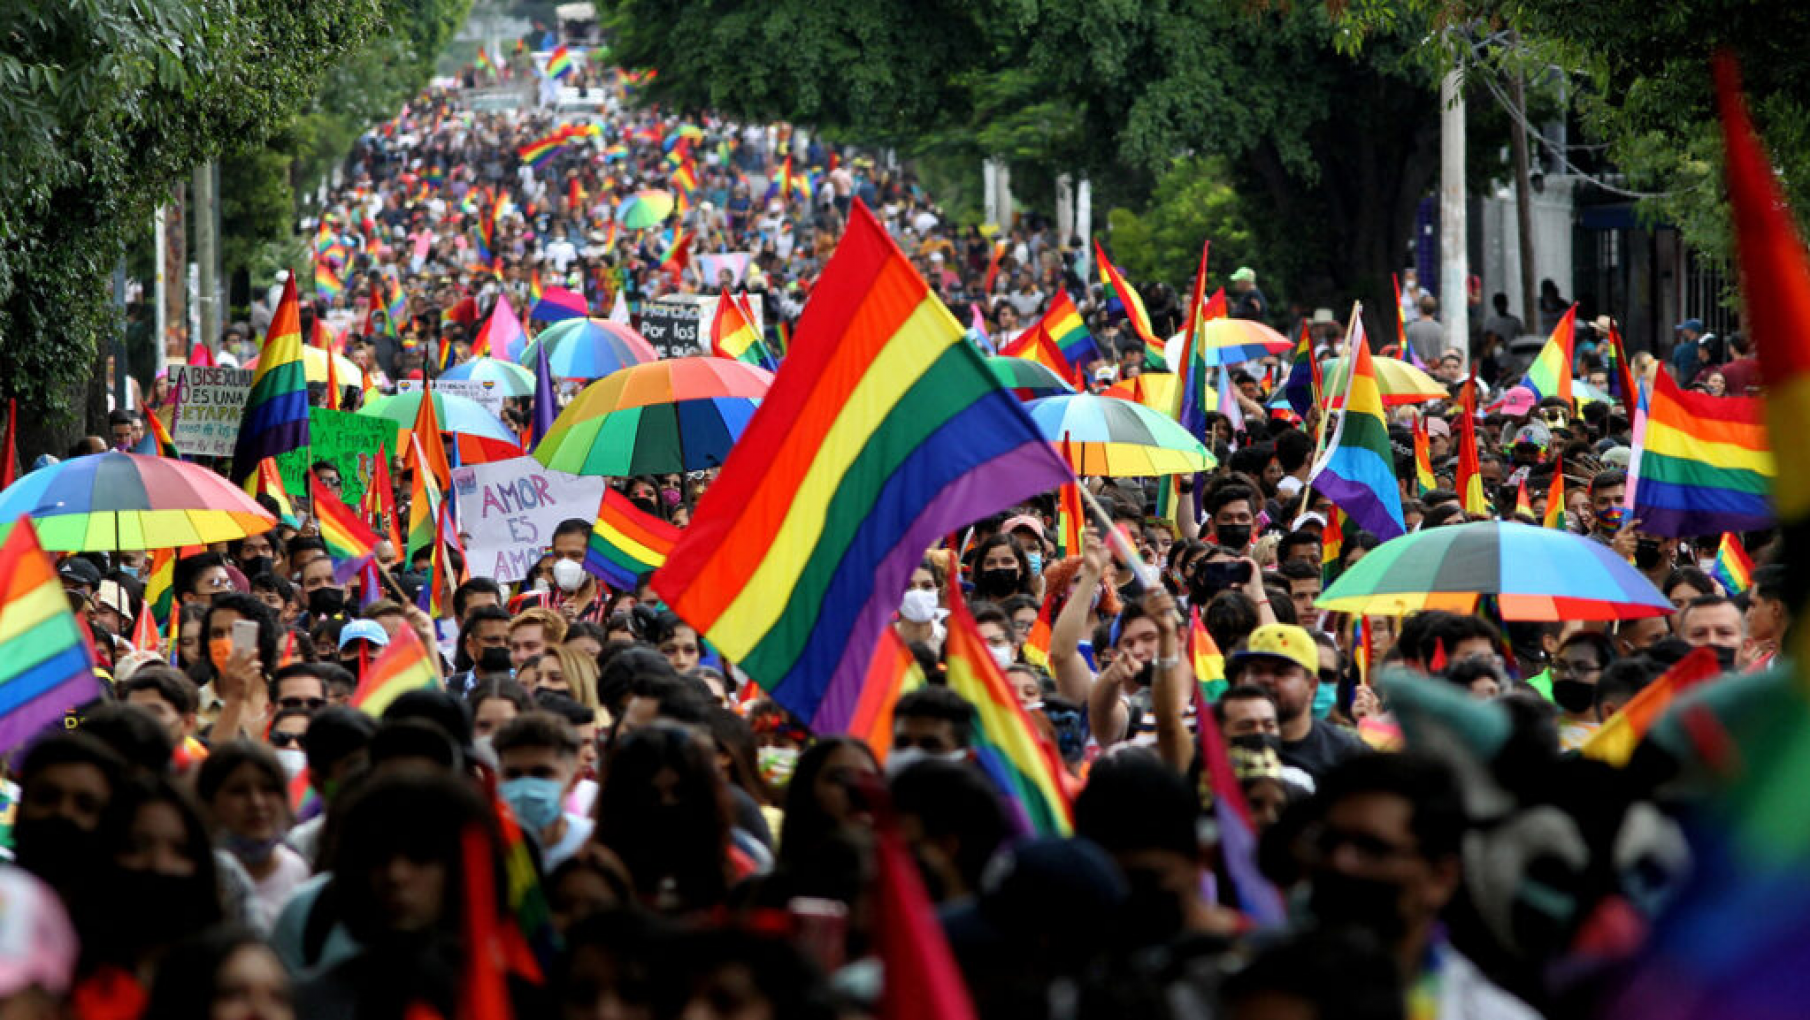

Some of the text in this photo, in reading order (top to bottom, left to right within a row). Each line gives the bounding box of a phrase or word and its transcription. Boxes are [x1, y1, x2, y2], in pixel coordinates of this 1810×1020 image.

[642, 321, 697, 340] Por los
[192, 388, 210, 404] ES
[213, 389, 244, 405] UNA
[482, 474, 557, 518] AMOR
[506, 515, 539, 544] ES
[493, 545, 546, 581] AMO
